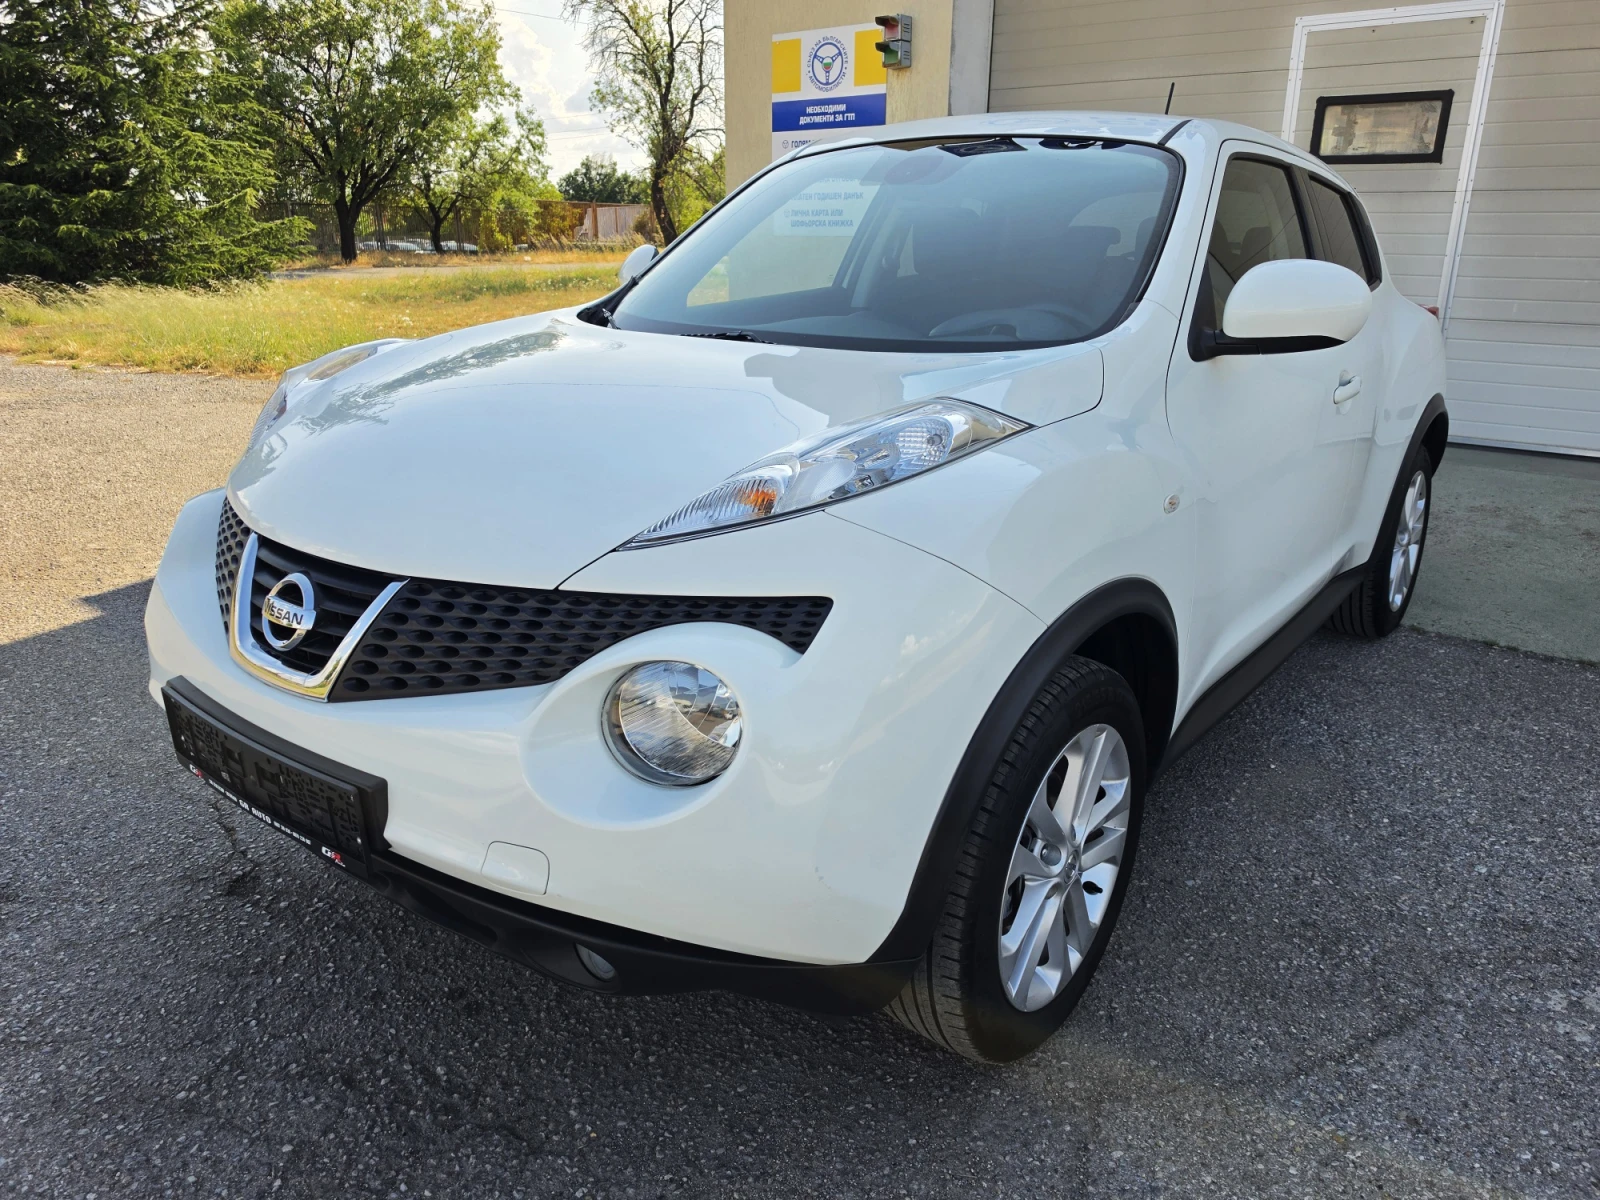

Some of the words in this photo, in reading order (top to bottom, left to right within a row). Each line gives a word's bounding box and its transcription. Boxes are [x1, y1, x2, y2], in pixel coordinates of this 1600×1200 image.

[814, 39, 822, 48] НА
[822, 36, 849, 65] БЪЛГАРСКИТЕ
[809, 71, 847, 92] АВТОМОБИЛИСТИ
[806, 104, 846, 114] НЕОБХОДИМИ
[799, 115, 835, 125] ДОКУМЕНТИ
[844, 113, 855, 121] ГТП
[814, 192, 842, 201] ГОДИШЕН
[843, 192, 864, 200] ДАНЪК
[790, 209, 810, 217] ЛИЧНА
[811, 209, 829, 217] КАРТА
[830, 209, 844, 217] ИЛИ
[790, 220, 827, 228] ШОФЬОРСКА
[264, 597, 304, 625] NISSAN
[251, 807, 272, 824] AUTO
